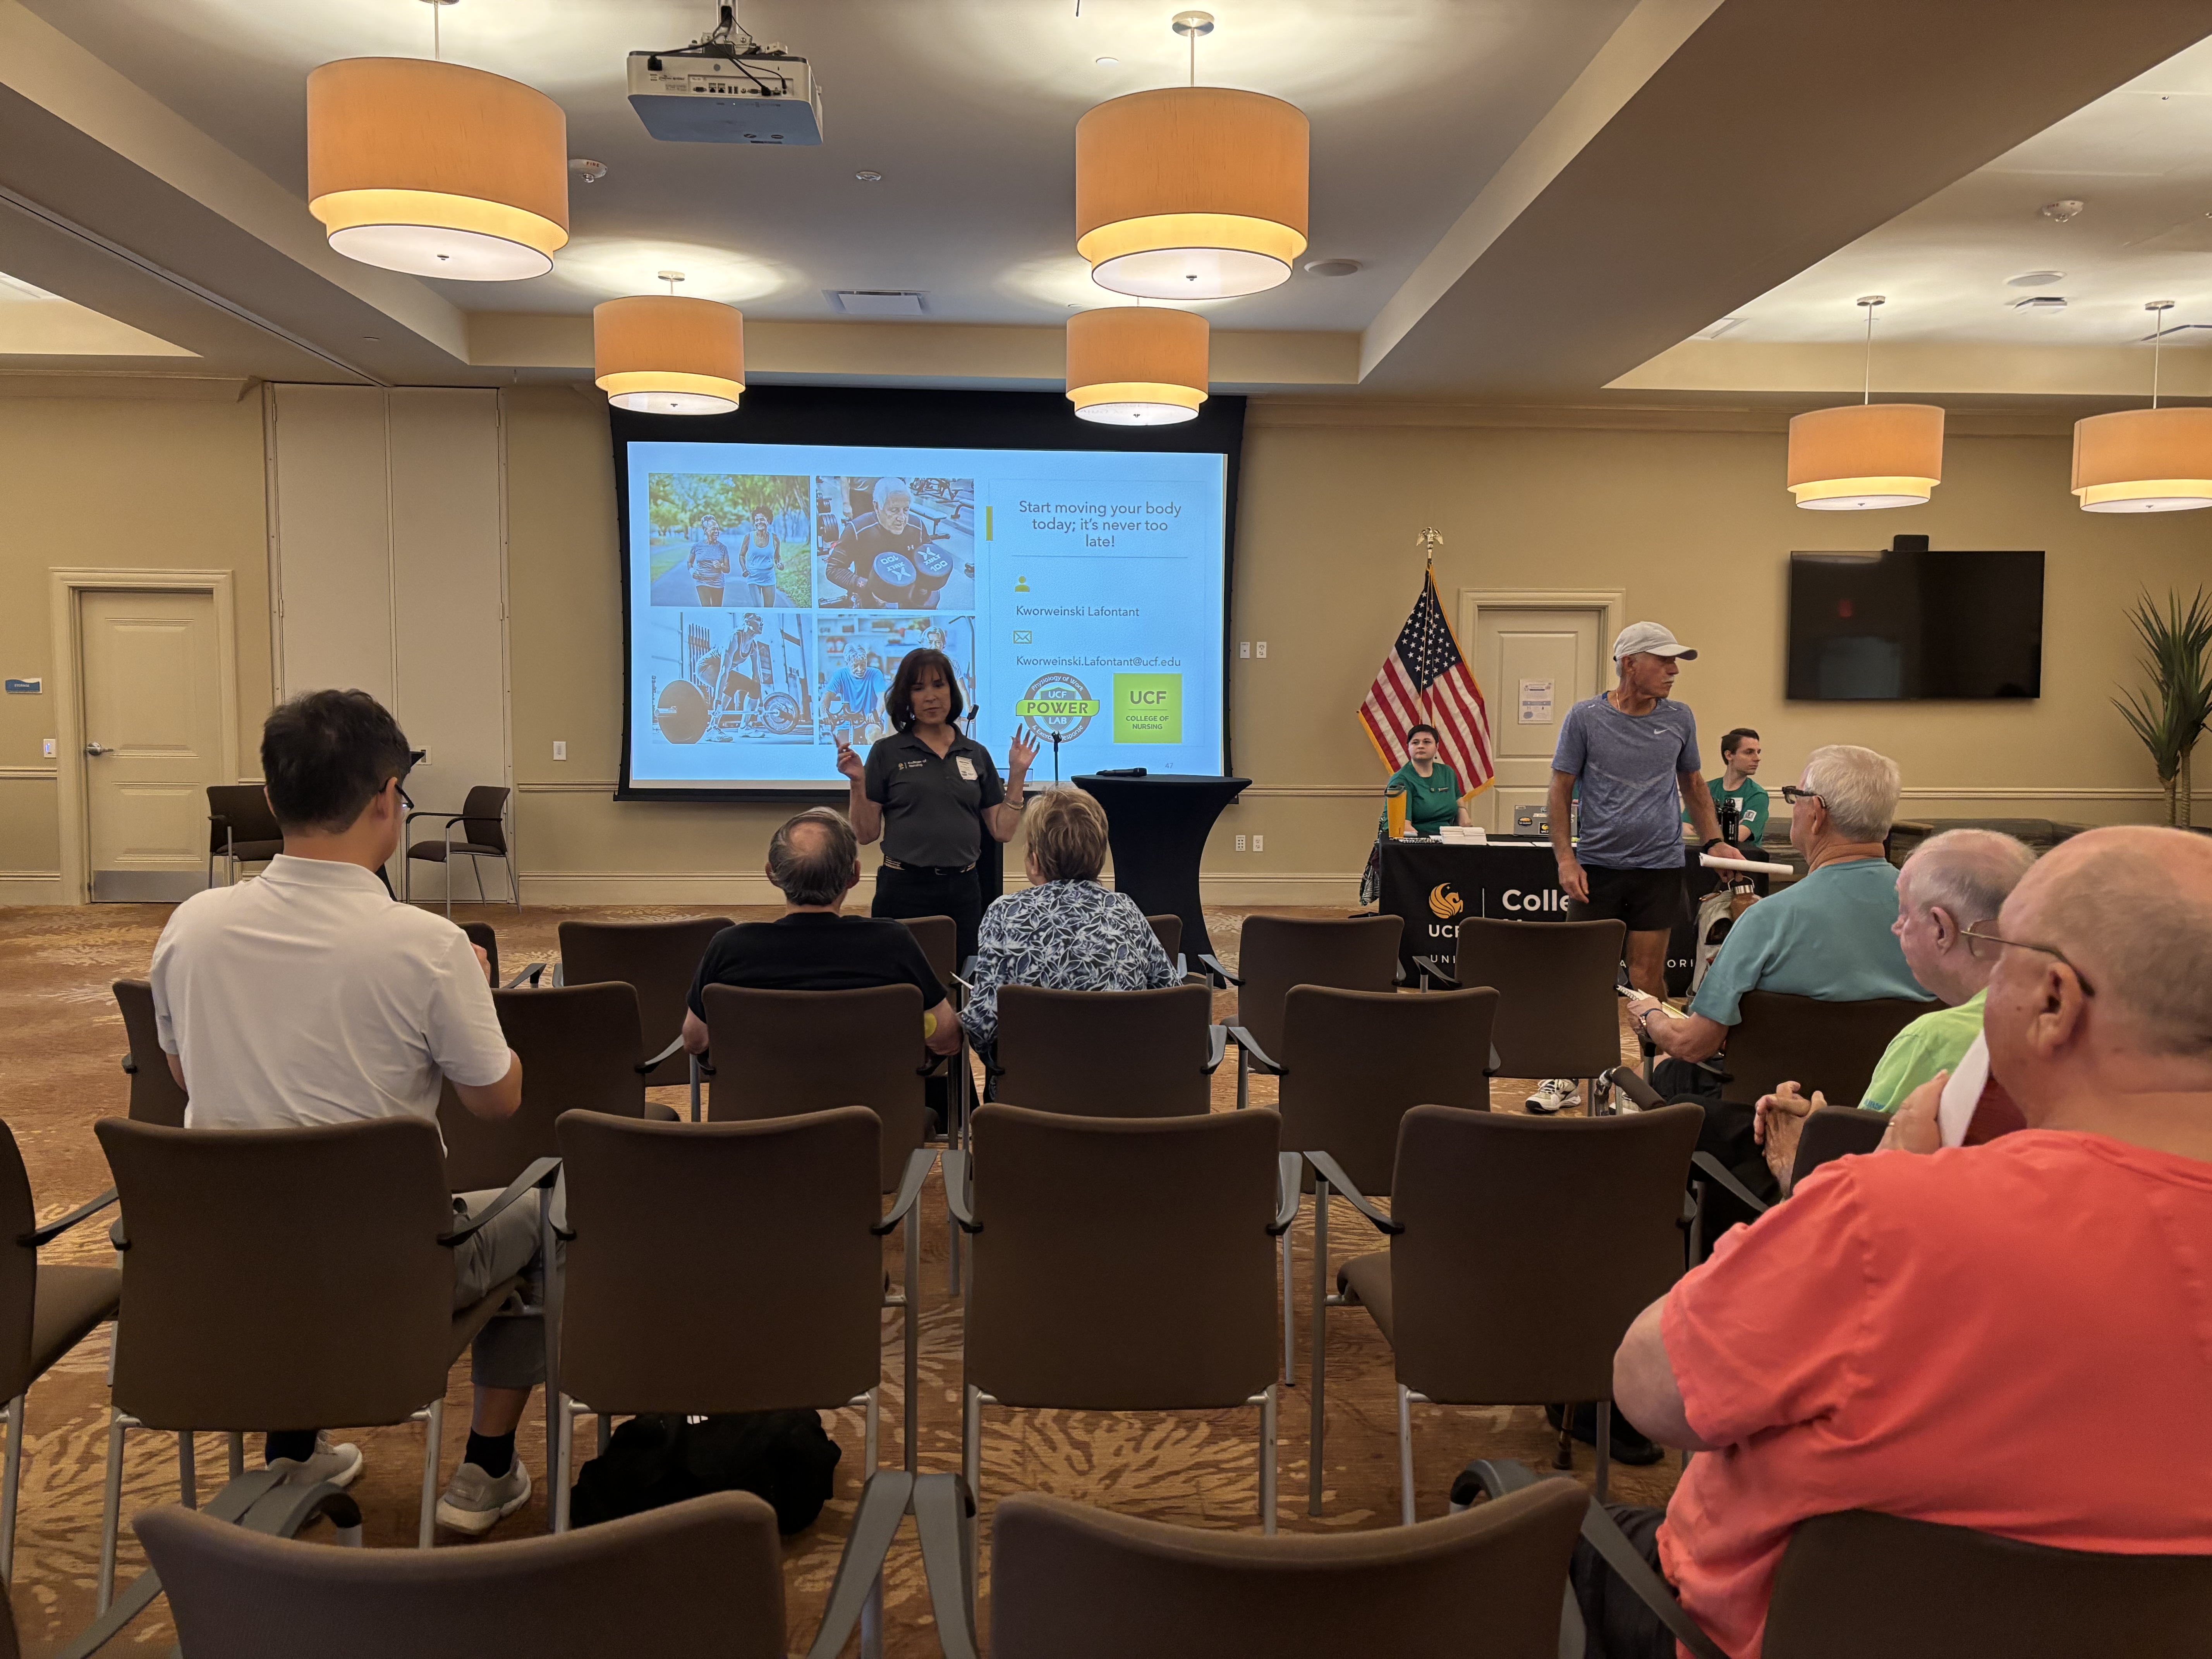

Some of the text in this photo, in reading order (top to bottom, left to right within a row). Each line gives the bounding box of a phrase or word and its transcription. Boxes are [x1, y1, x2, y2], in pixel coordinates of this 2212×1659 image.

[1019, 500, 1182, 518] Start moving your body
[1032, 517, 1075, 533] today;
[1103, 522, 1142, 531] never
[1145, 520, 1168, 531] too
[1085, 534, 1115, 547] late!
[930, 560, 948, 572] 100
[1016, 606, 1140, 617] Kworweinski Lafontant
[1016, 656, 1181, 667] Kworweinski.Lafontant@ucf.edu
[1031, 676, 1062, 691] Physiology
[1070, 678, 1084, 692] Work
[1048, 690, 1067, 699] UCF
[1130, 690, 1167, 704] UCF
[1027, 702, 1088, 714] POWER
[1502, 889, 1569, 912] Colle
